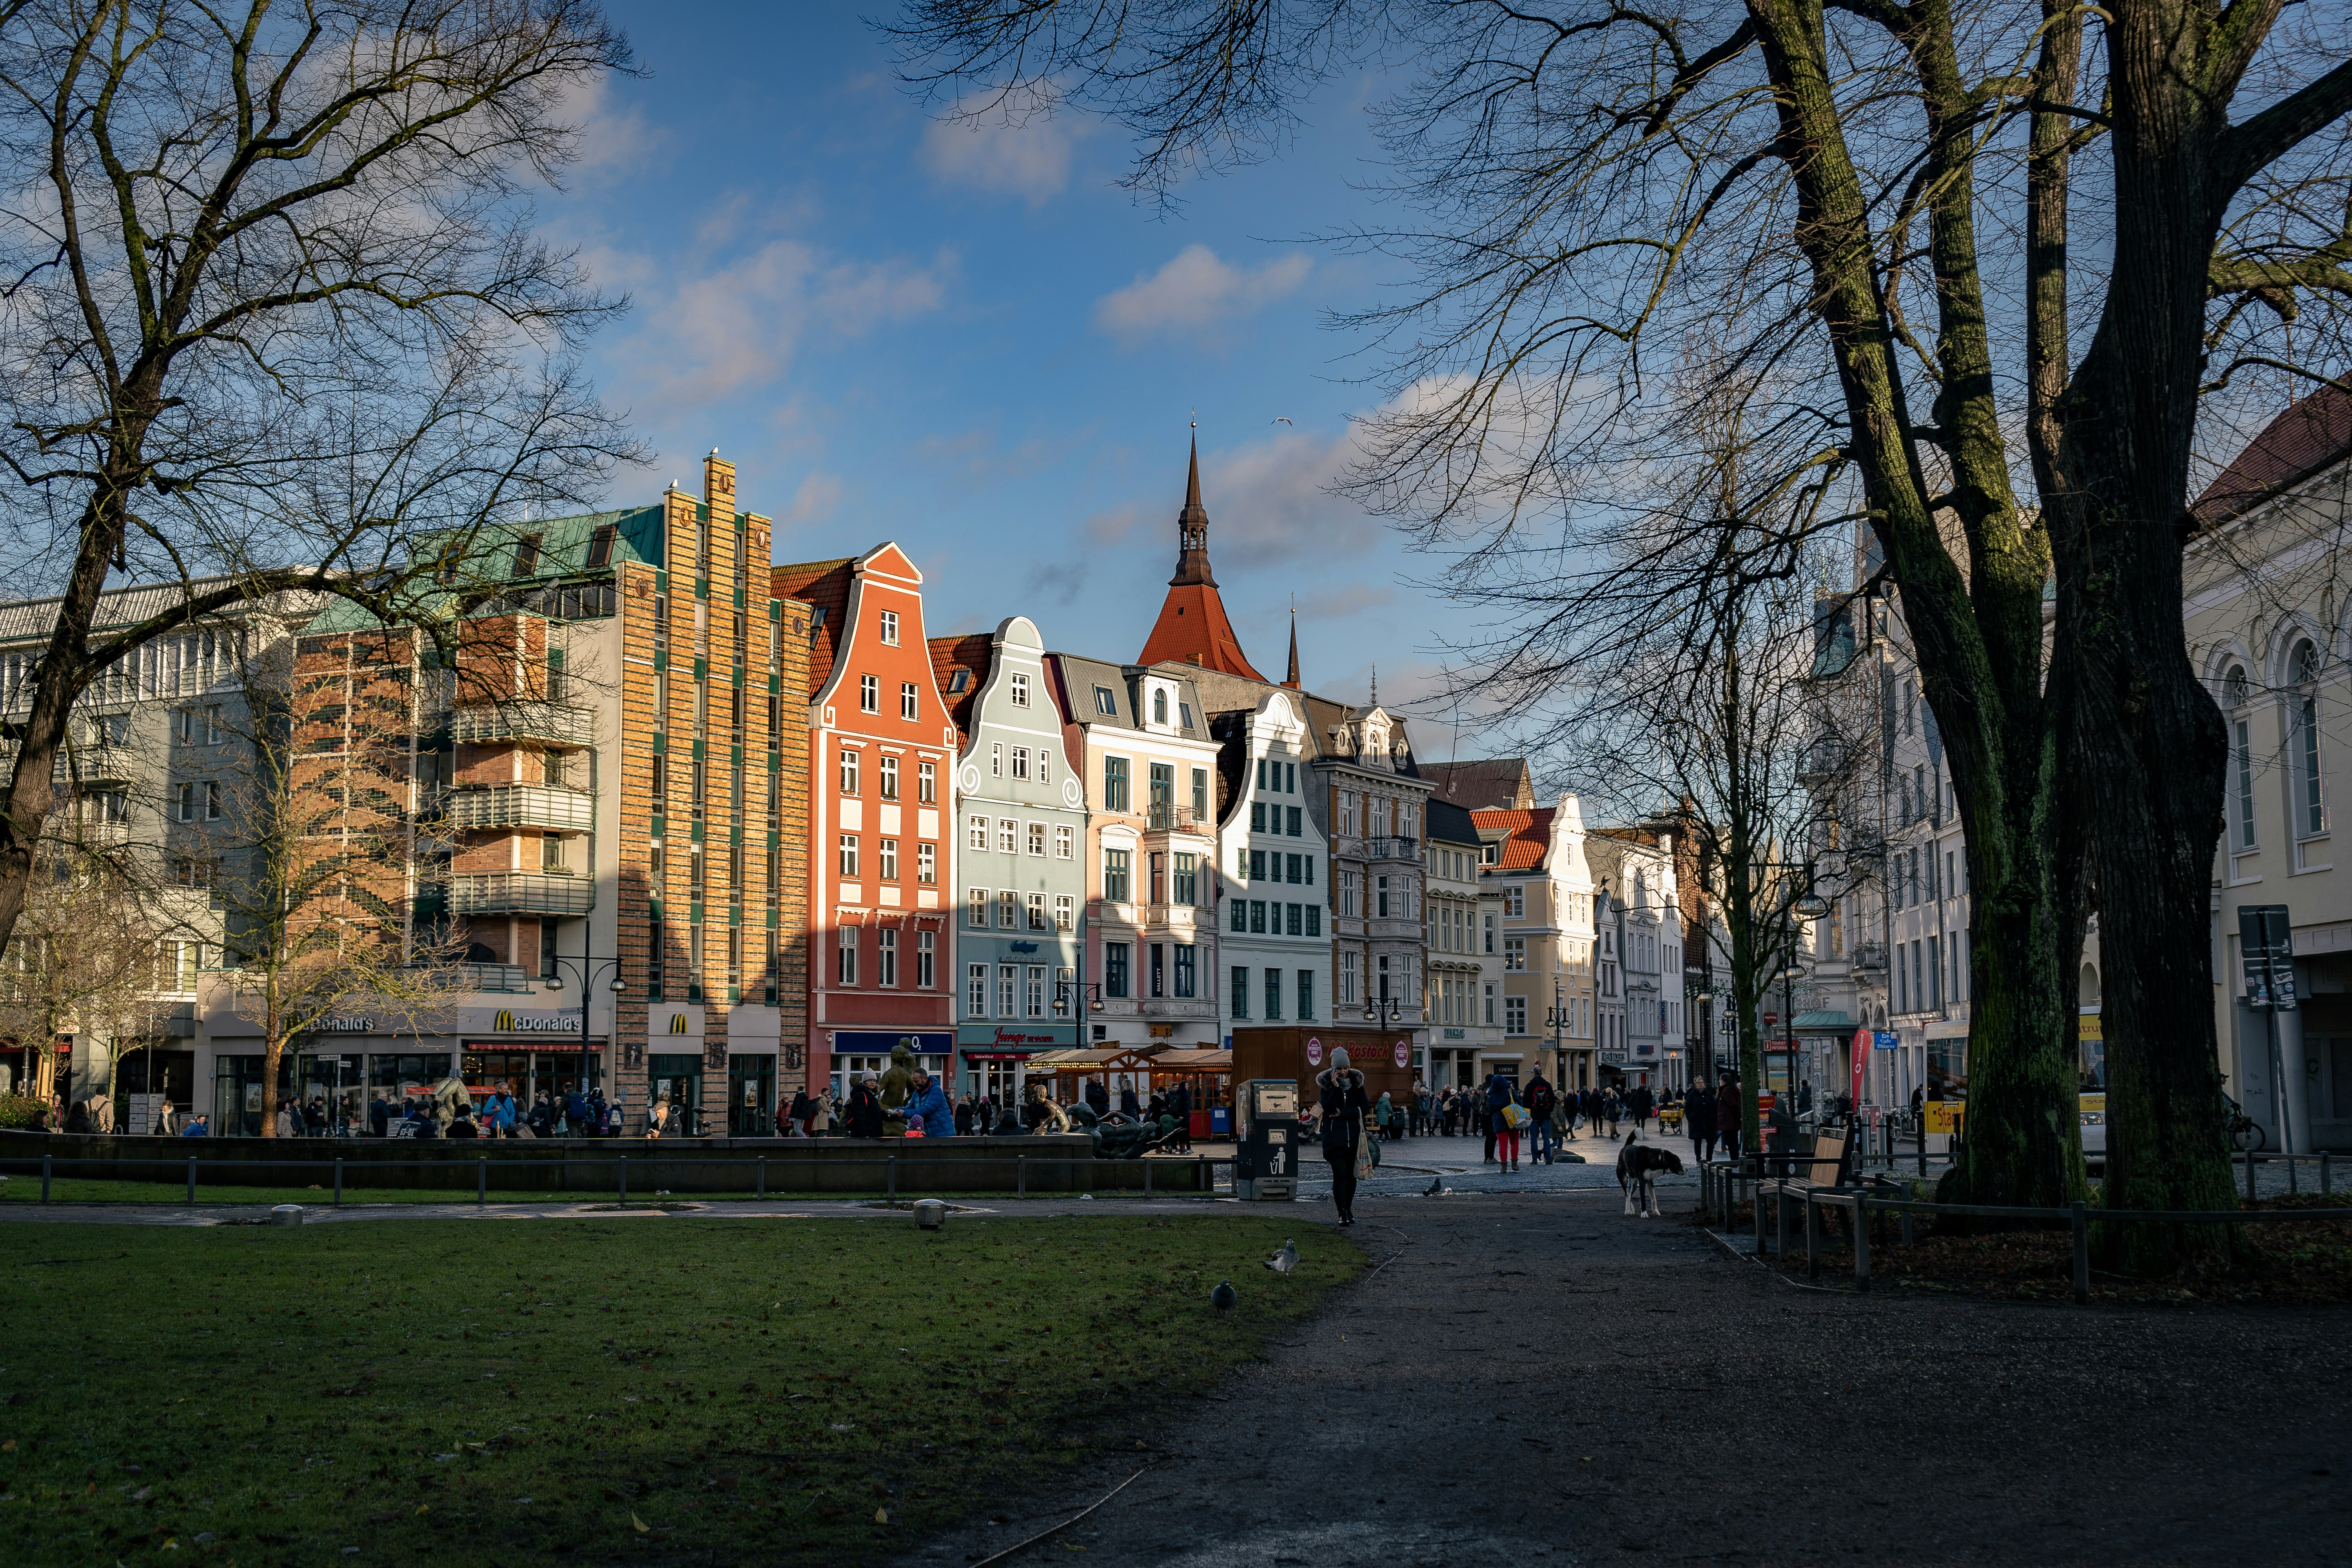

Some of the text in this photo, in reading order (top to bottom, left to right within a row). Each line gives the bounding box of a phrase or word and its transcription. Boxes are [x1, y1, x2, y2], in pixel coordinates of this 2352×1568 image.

[496, 1009, 581, 1031] McDonald's
[991, 1026, 1027, 1049] Junge
[1444, 1027, 1465, 1038] DOUGLAS
[2079, 1025, 2102, 1033] tru
[911, 1036, 922, 1051] O2
[1348, 1040, 1390, 1059] Rostock
